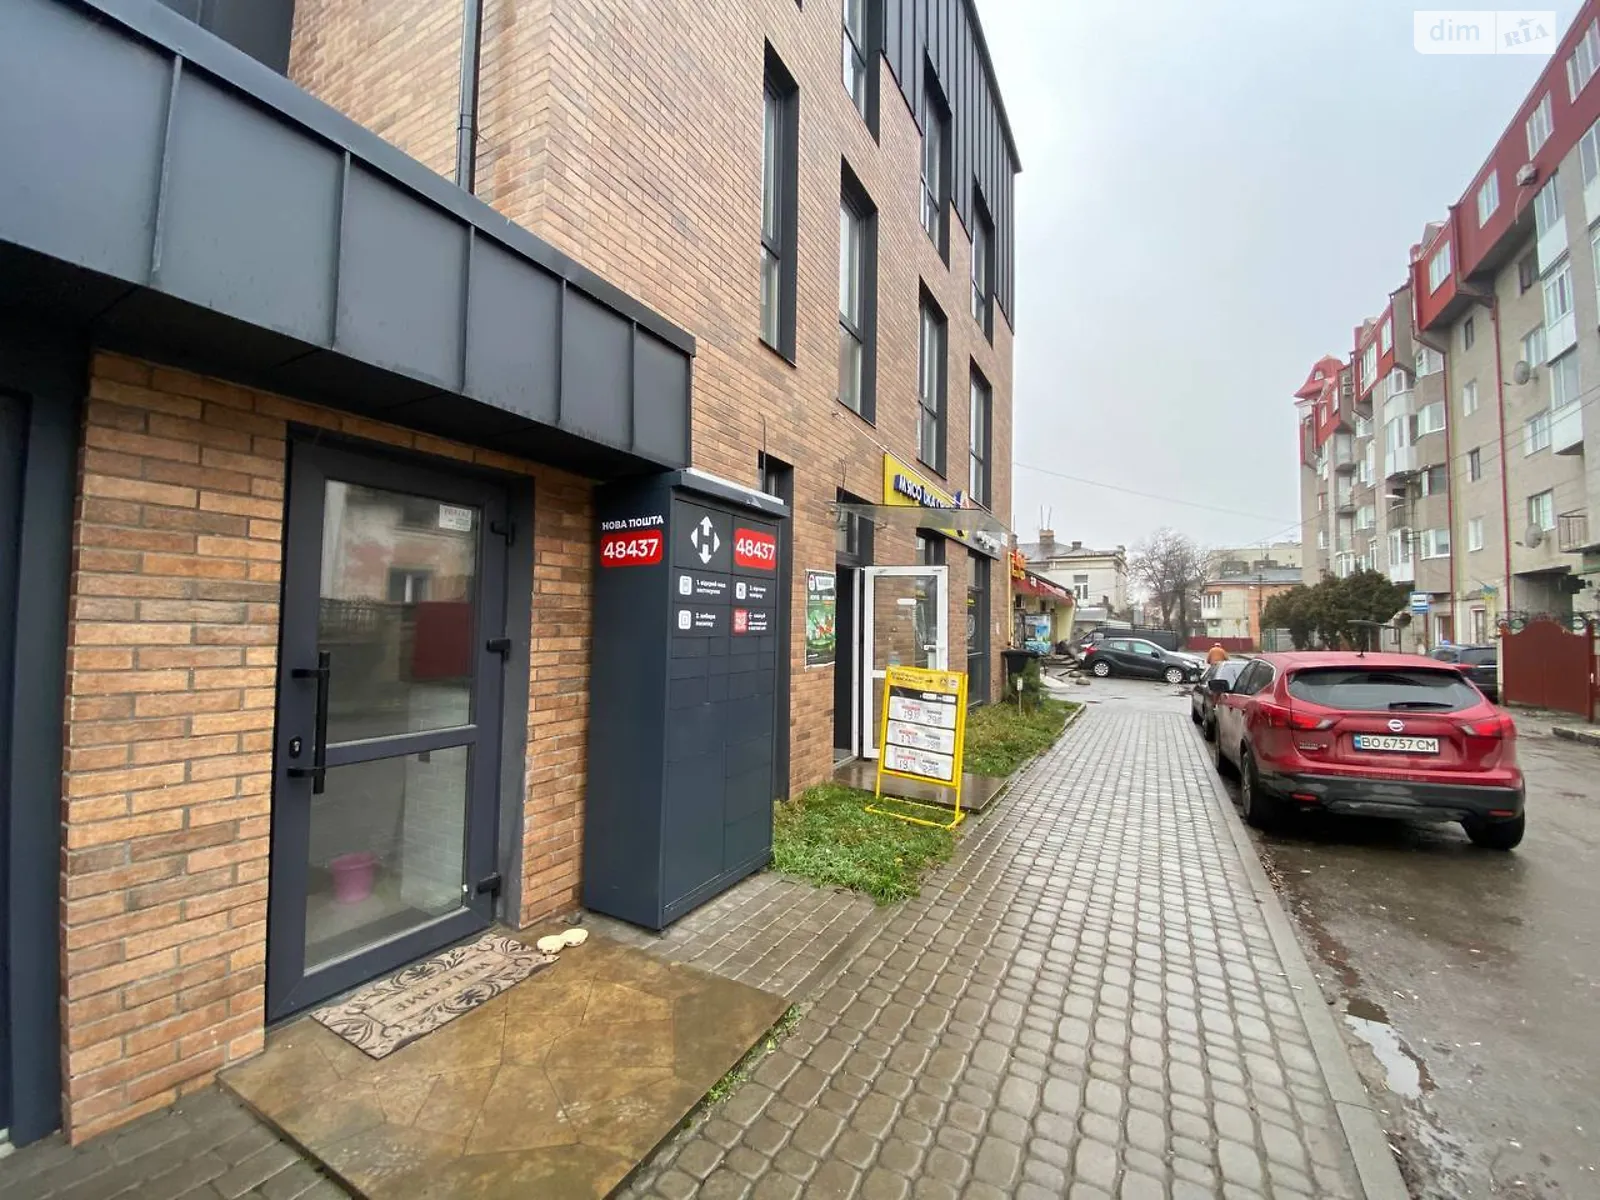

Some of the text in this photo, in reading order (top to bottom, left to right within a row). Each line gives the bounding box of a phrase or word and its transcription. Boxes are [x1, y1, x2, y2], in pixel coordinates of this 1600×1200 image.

[602, 515, 664, 530] НОВА ПОШТА
[603, 538, 659, 559] 48437
[735, 537, 776, 561] 48437
[1361, 737, 1437, 751] BO 6757 CM
[395, 961, 492, 1012] WELCOME
